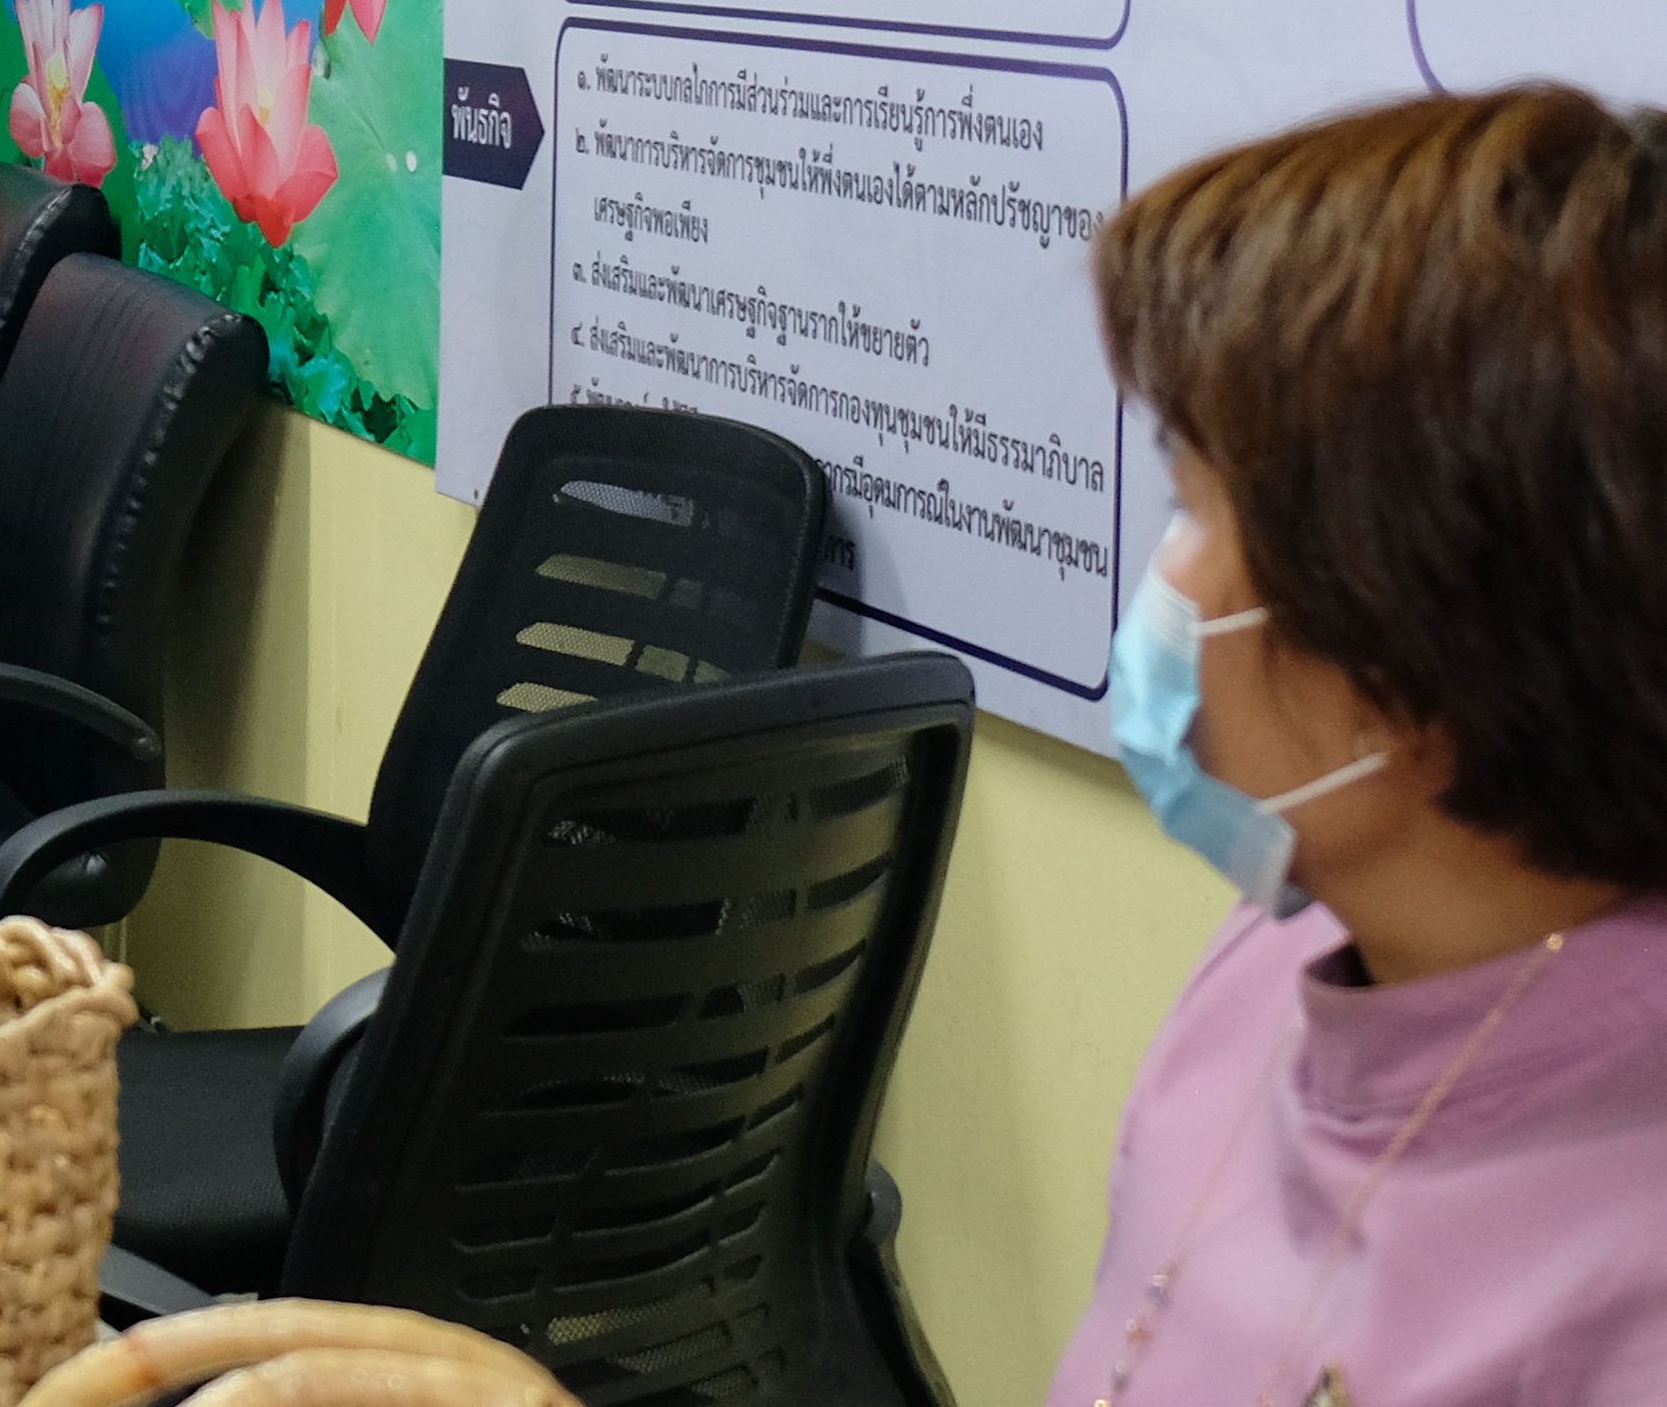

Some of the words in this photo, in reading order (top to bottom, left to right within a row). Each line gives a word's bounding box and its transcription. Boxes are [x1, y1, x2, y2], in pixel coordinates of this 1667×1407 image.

[451, 86, 512, 149] พันธกิจ
[594, 191, 708, 245] เศรษฐกิจพอเพียง
